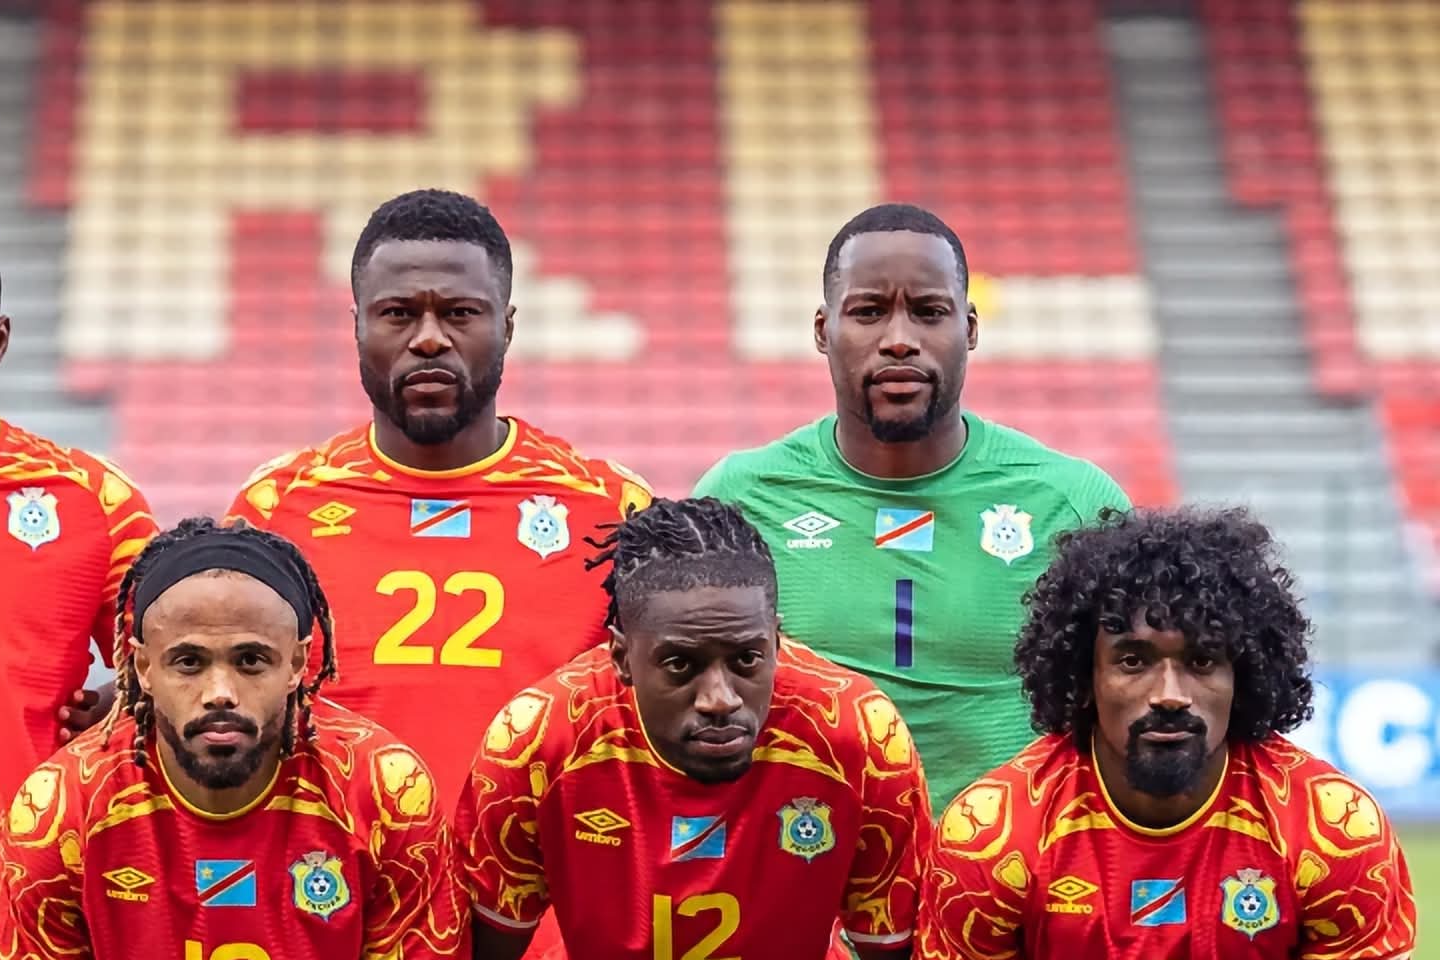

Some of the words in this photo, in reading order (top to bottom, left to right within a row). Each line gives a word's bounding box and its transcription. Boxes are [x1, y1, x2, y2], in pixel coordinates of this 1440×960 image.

[373, 570, 505, 668] 22
[895, 579, 913, 668] 1
[575, 830, 622, 848] umbro
